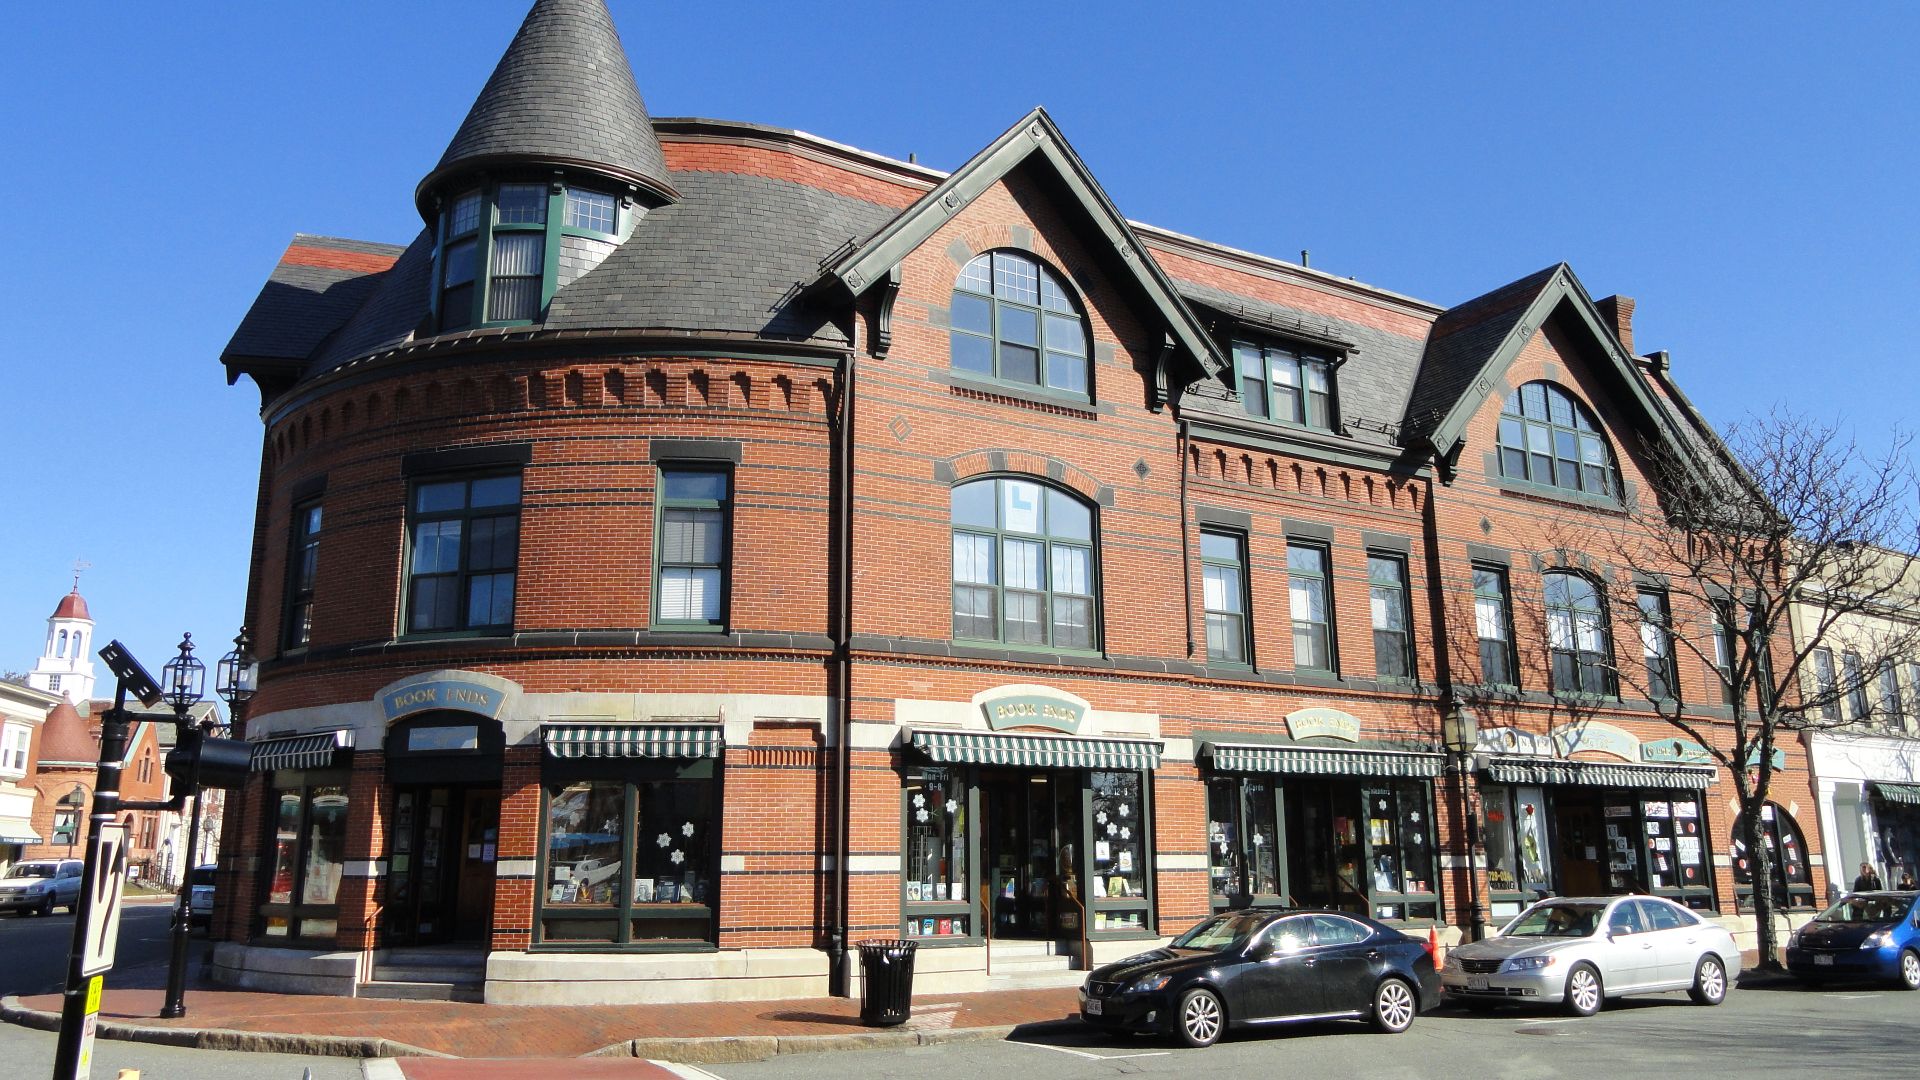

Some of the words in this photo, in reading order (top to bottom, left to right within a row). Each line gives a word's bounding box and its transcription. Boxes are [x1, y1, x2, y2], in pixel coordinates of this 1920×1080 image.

[395, 688, 436, 709] BOOK
[446, 688, 489, 705] ENDS
[997, 703, 1037, 719] BOOK
[1043, 704, 1076, 723] ENDS
[1295, 716, 1325, 730] BOOK
